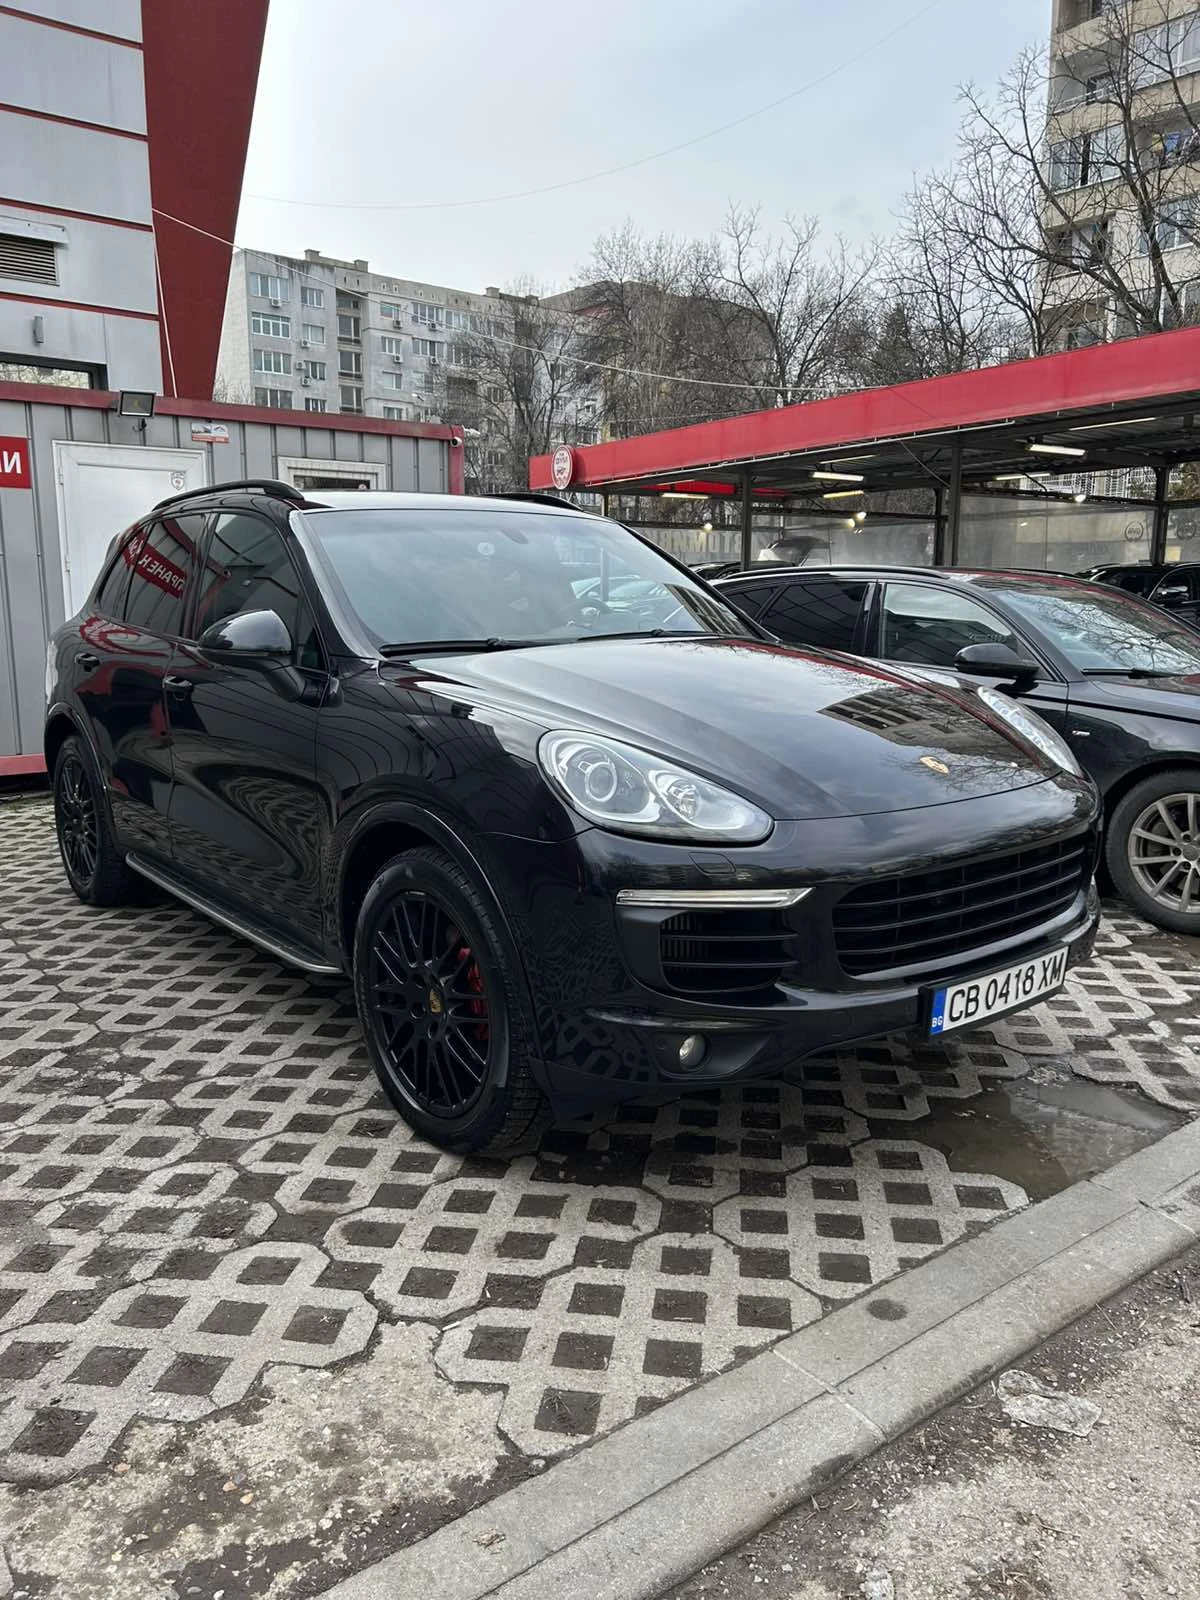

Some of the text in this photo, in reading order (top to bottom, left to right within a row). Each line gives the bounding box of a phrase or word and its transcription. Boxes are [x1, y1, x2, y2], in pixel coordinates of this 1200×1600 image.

[948, 952, 1065, 1022] CB 0418 XM
[931, 1016, 943, 1028] BG
